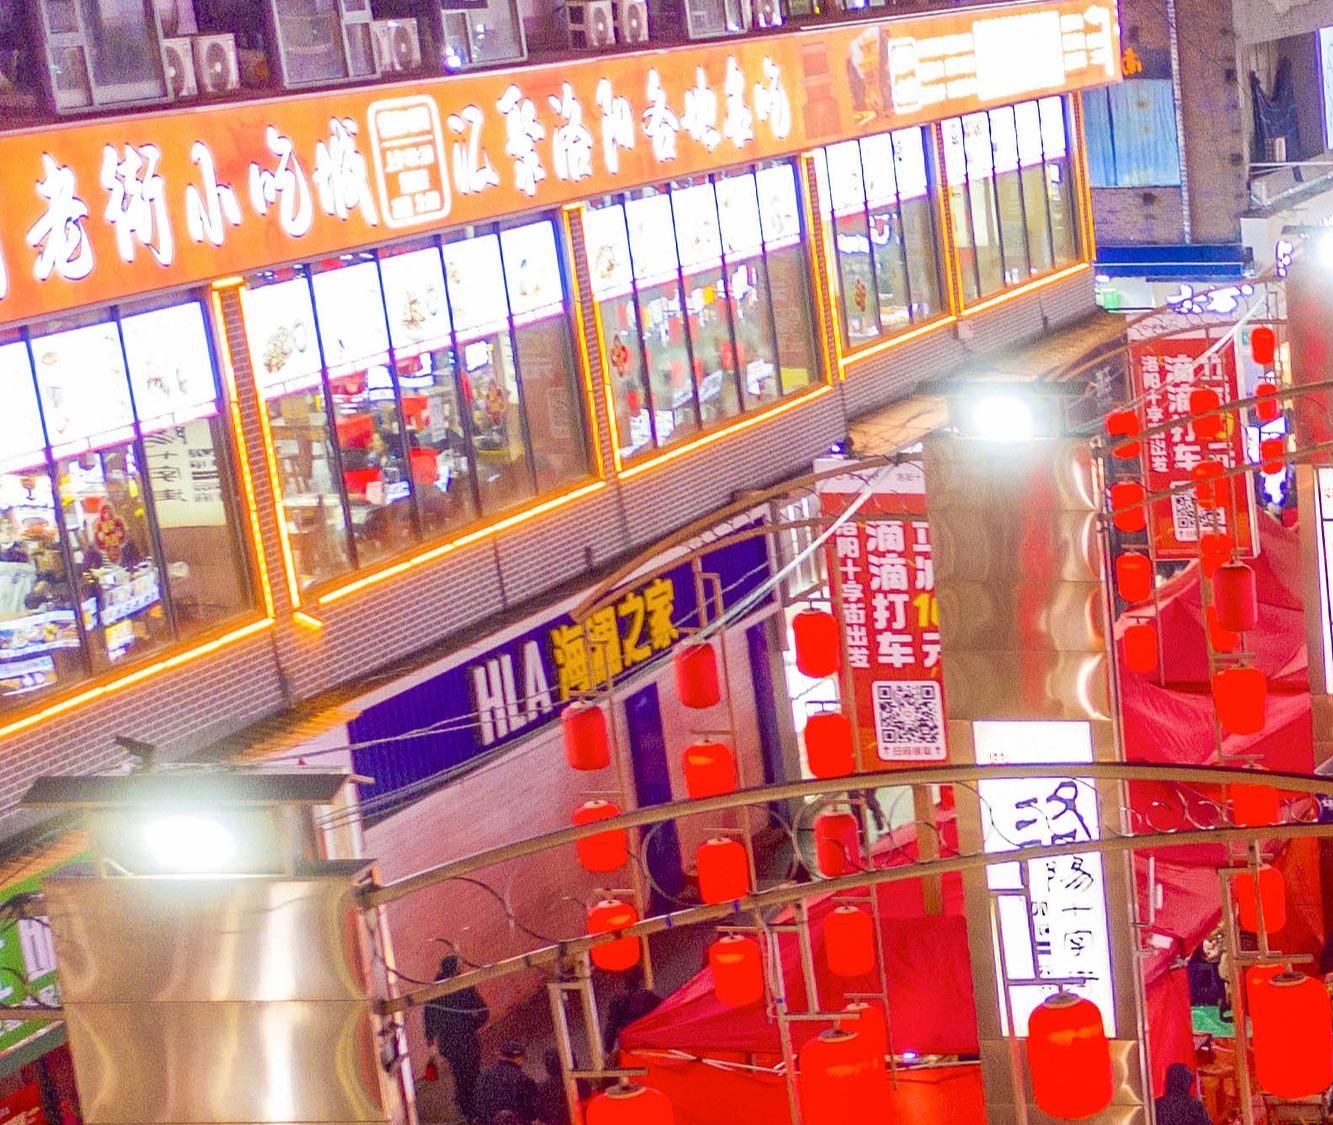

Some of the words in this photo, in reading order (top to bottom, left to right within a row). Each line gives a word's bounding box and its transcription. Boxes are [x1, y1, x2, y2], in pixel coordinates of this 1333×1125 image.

[0, 117, 379, 298] 老街小吃城
[864, 519, 915, 669] 滴滴打车
[474, 640, 553, 746] HLA
